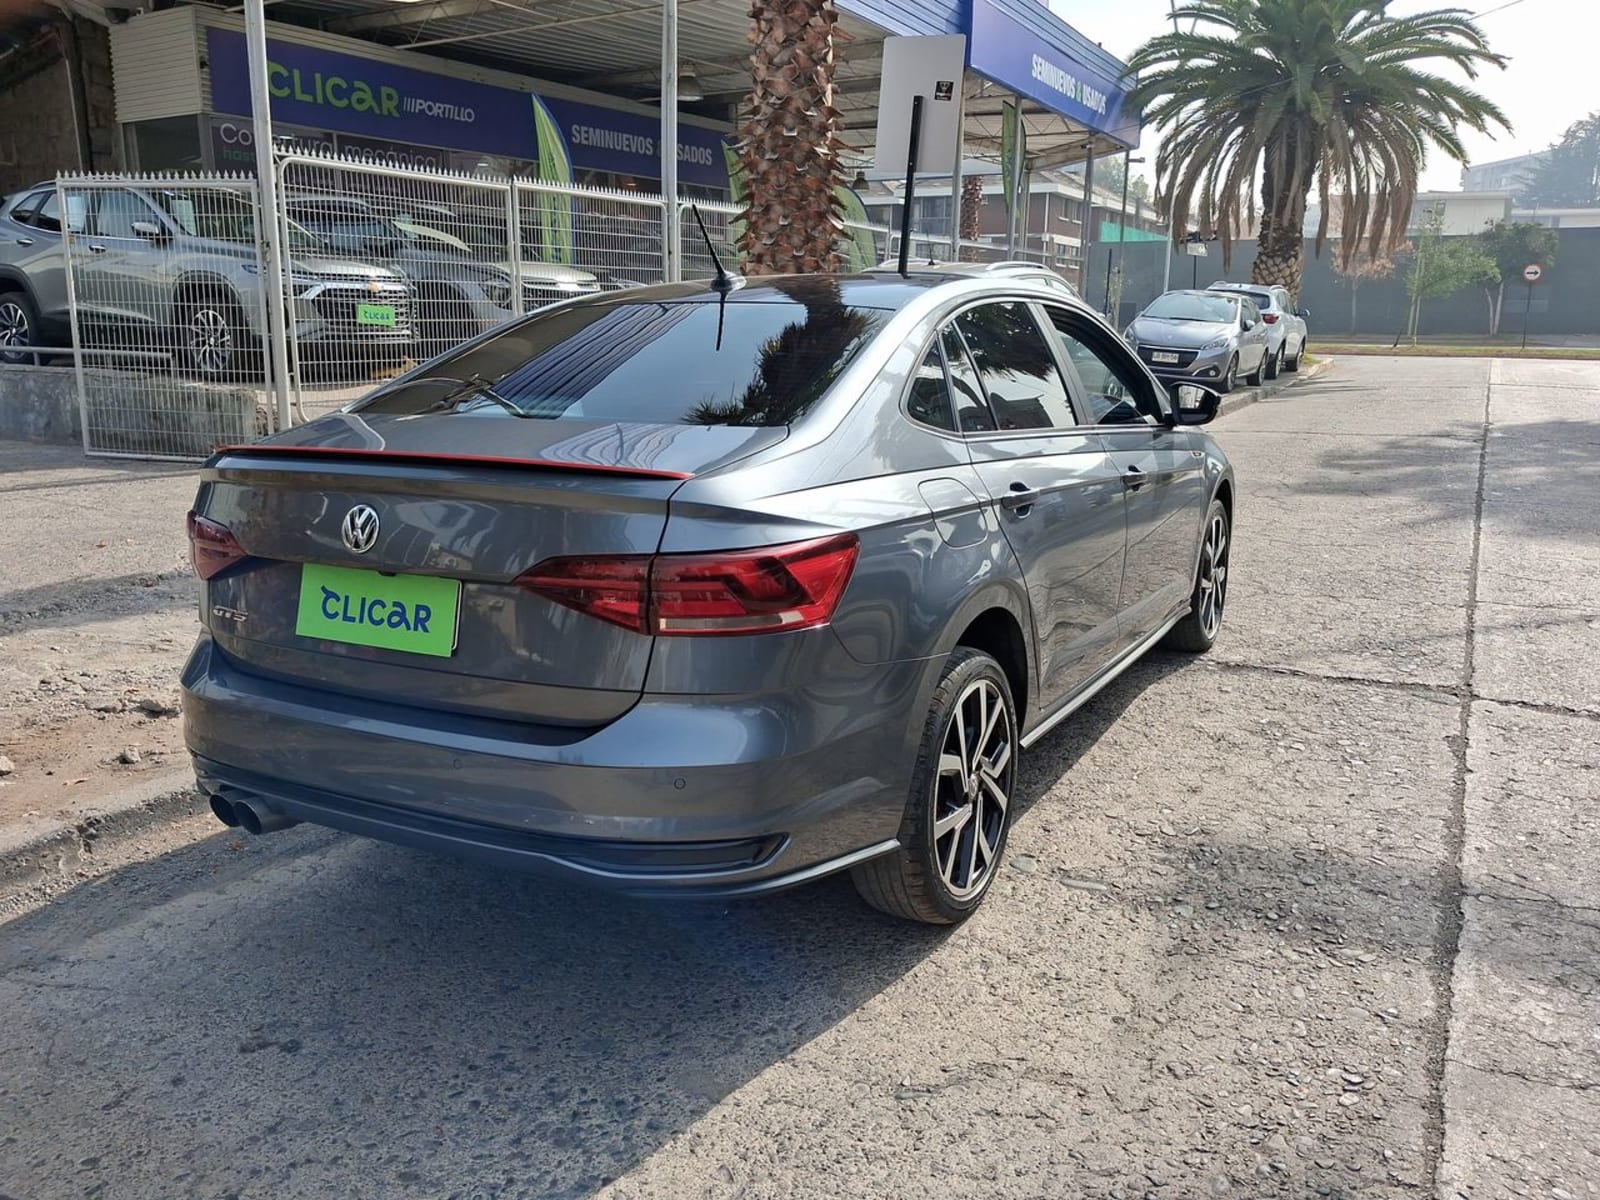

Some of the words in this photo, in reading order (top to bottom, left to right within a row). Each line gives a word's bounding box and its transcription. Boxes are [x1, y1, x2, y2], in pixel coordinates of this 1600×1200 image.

[1032, 54, 1076, 99] SEMINUEVOS
[572, 124, 653, 155] SEMINUEVOS
[677, 143, 712, 166] SADOS
